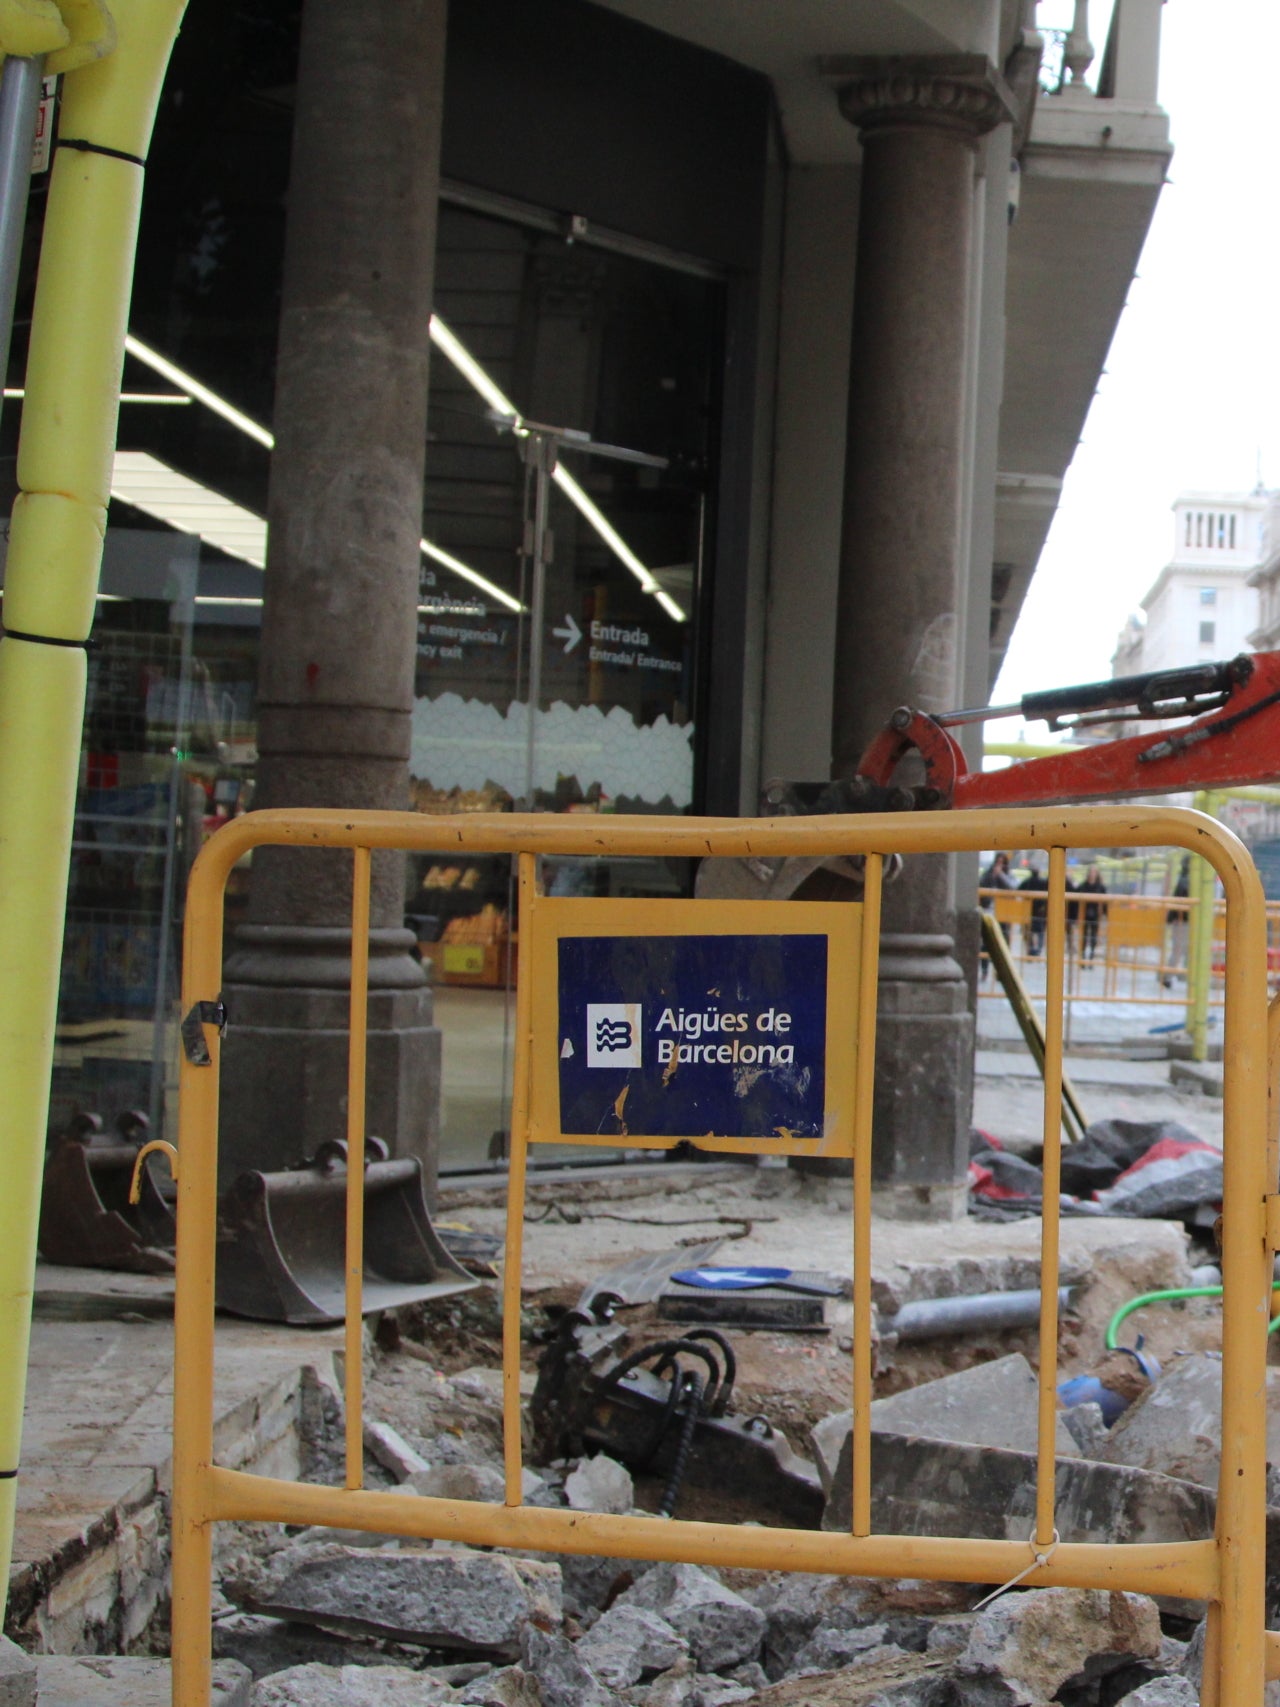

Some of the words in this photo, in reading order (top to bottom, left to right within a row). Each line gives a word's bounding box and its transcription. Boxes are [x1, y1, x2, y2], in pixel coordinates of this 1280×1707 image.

[590, 620, 649, 646] Entrada
[637, 653, 683, 672] Entrance
[655, 1007, 748, 1039] Aigües
[756, 1007, 792, 1032] de
[657, 1040, 795, 1064] Barcelona
